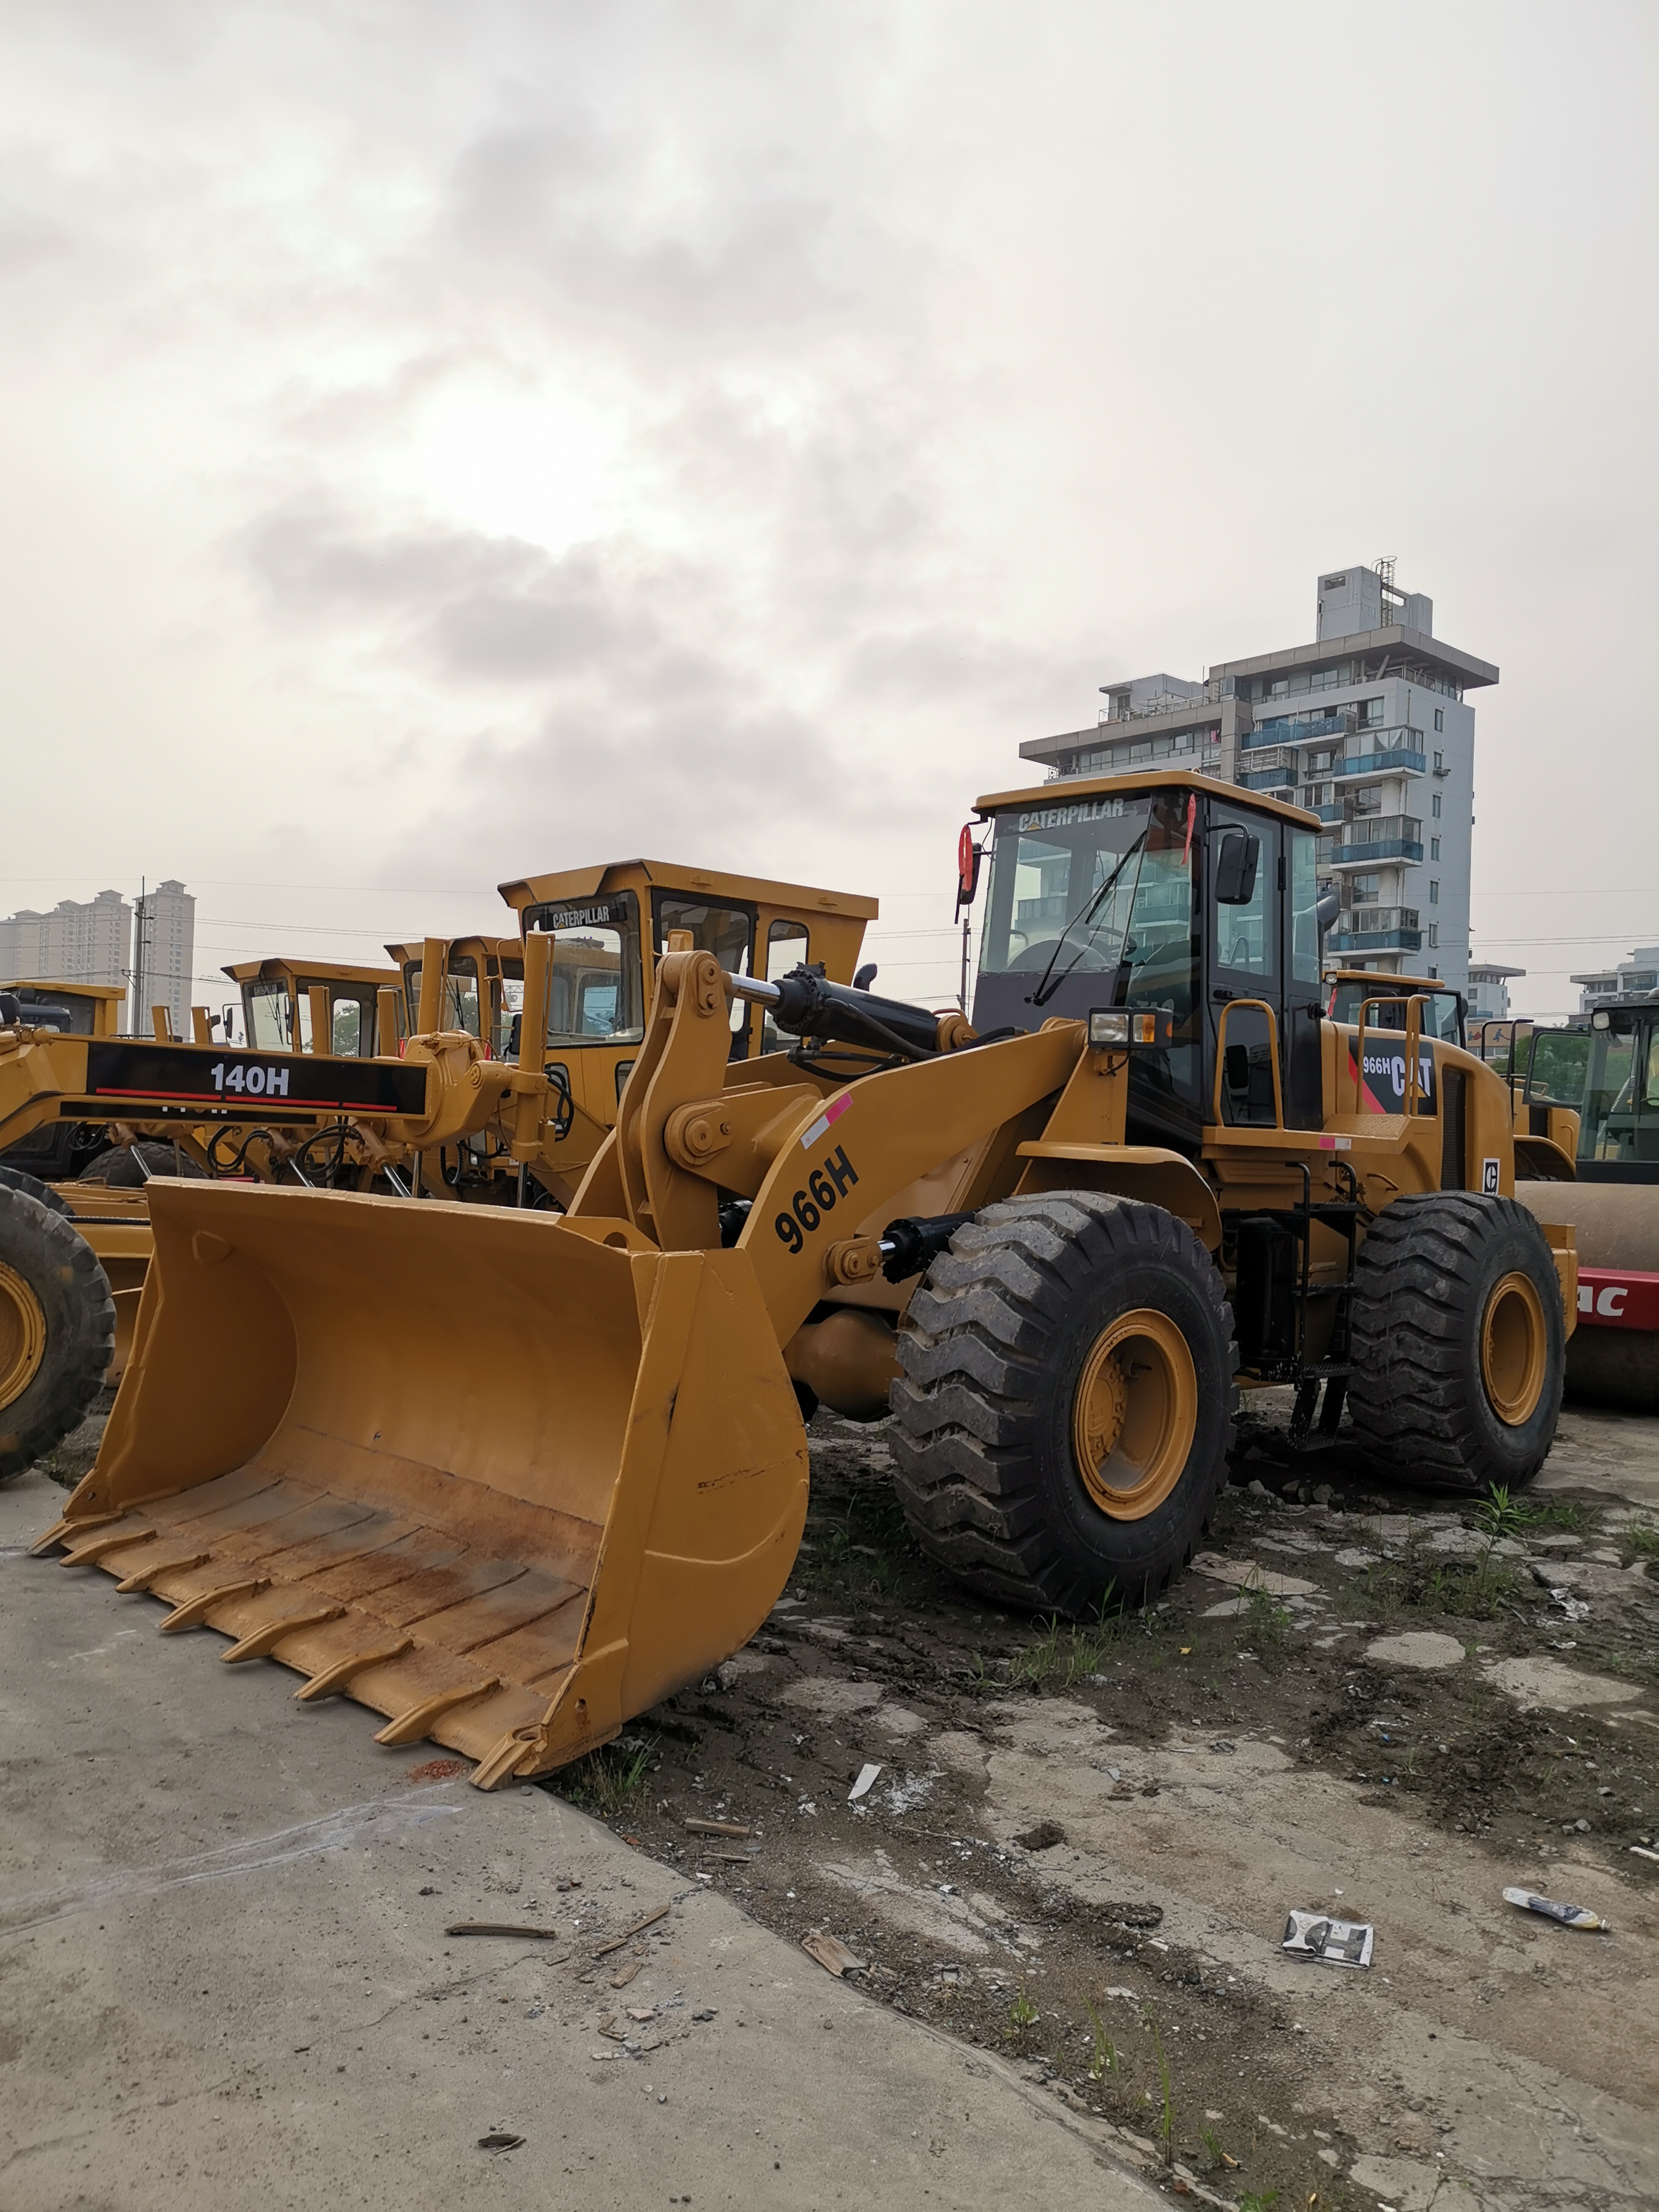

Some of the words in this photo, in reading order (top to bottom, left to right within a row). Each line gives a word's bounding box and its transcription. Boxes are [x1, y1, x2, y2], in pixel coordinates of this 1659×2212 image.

[1019, 798, 1124, 833] CATERPILLAR
[552, 906, 609, 929] CATERPILLAR
[211, 1063, 289, 1096] 140H
[1362, 1056, 1390, 1074] 966H
[775, 1144, 859, 1255] 966H
